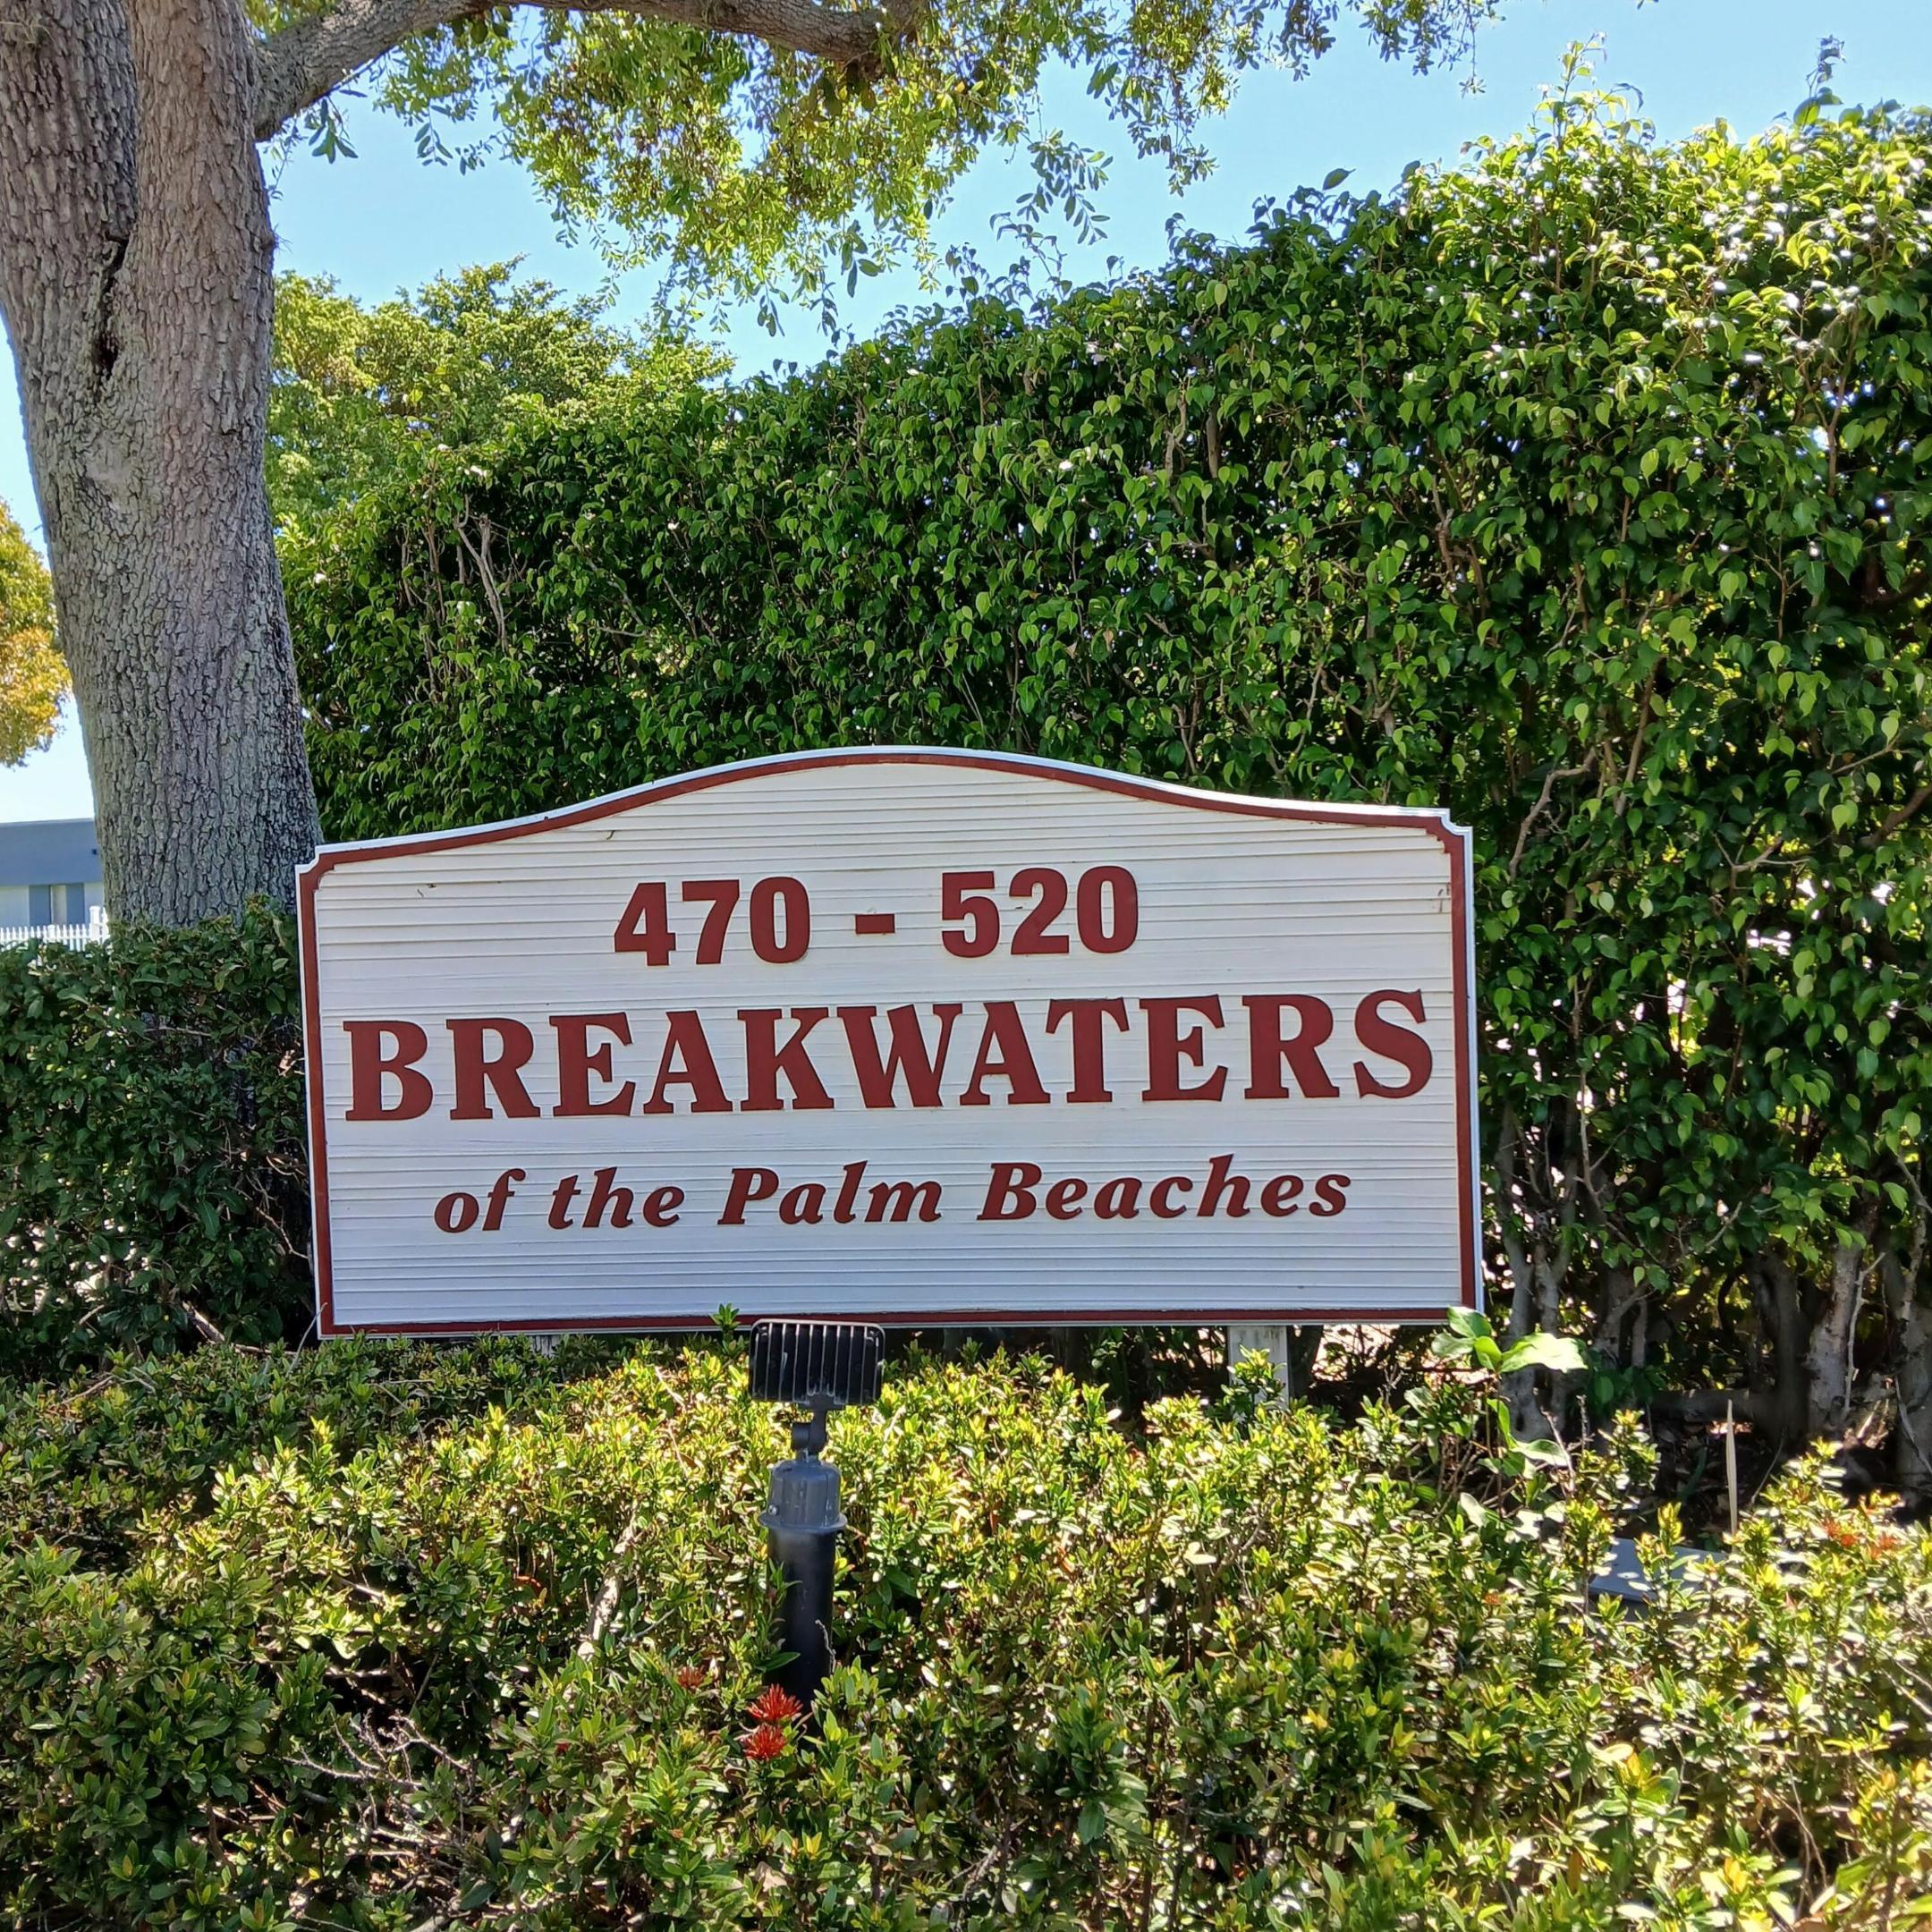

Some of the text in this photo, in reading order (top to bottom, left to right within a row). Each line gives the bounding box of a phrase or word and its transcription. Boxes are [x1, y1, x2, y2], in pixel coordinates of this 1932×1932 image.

[614, 866, 1139, 966] 470 - 520
[343, 989, 1433, 1122] BREAKWATERS
[435, 1154, 1351, 1233] of the Palm Beaches
